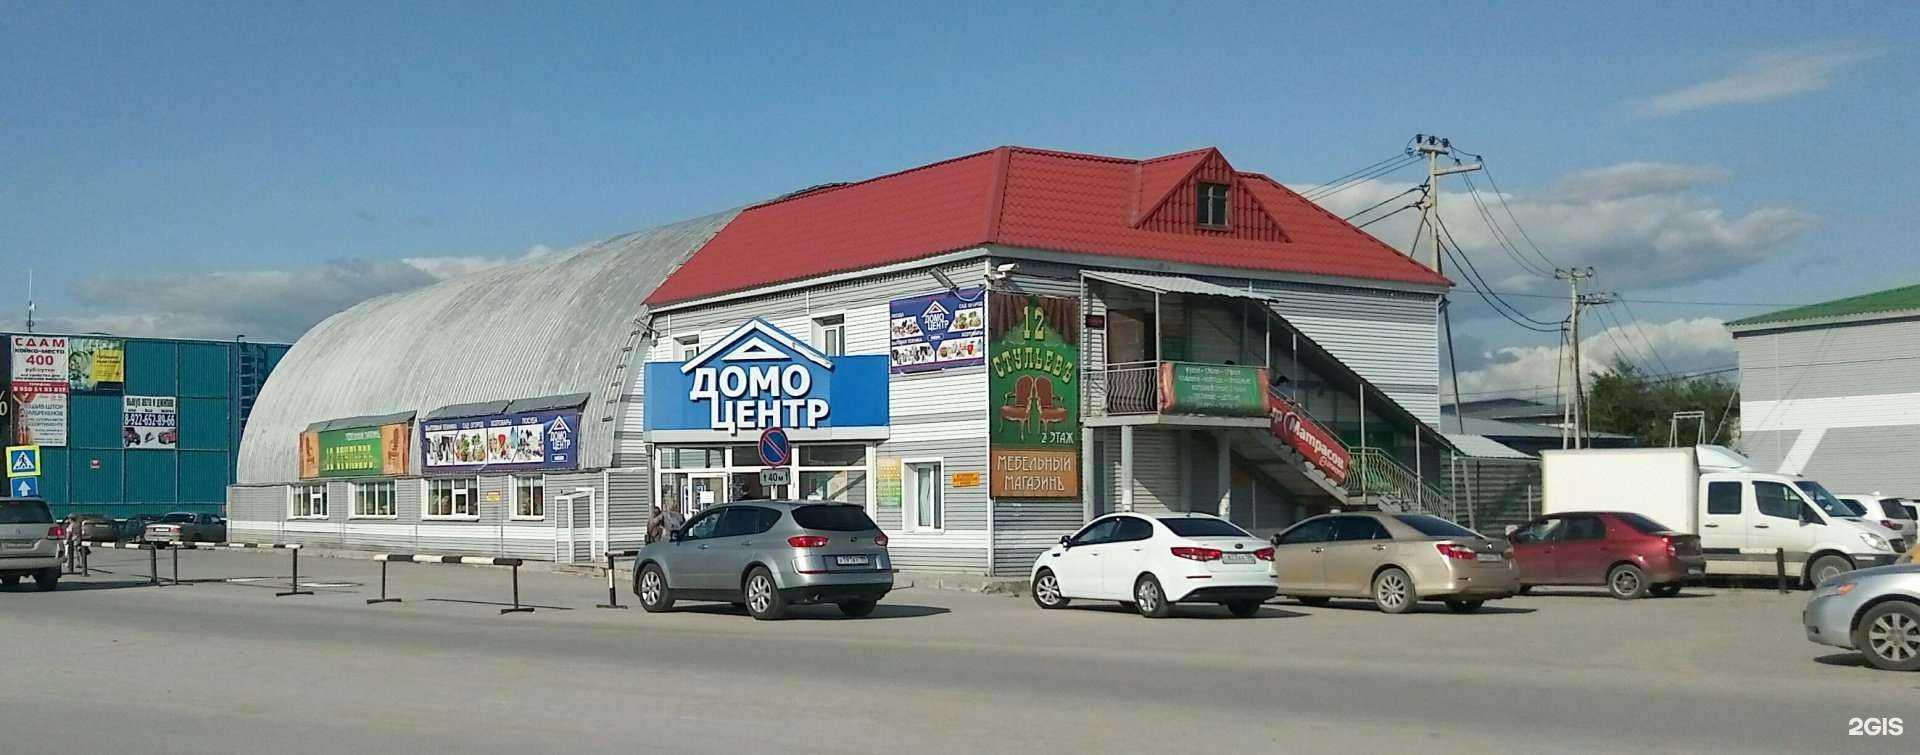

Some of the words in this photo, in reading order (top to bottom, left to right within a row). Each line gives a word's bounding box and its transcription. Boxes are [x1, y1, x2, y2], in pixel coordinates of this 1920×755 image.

[924, 313, 945, 325] ДОМО
[1023, 305, 1045, 340] 12
[927, 320, 950, 332] ЦЕНТР
[15, 338, 65, 348] СДАМ
[26, 355, 54, 365] 400
[689, 364, 812, 400] ДОМО
[124, 413, 175, 426] 8-922-652-89-66
[710, 399, 830, 436] ЦЕНТР
[1041, 432, 1048, 444] 2
[1049, 432, 1074, 444] ЭТАЖ
[1288, 416, 1345, 470] Матрасов
[552, 439, 571, 452] ЦЕНТР
[997, 454, 1072, 472] МЕБЕЛЬНЫЙ
[1004, 475, 1065, 491] МАГАЗИНЪ
